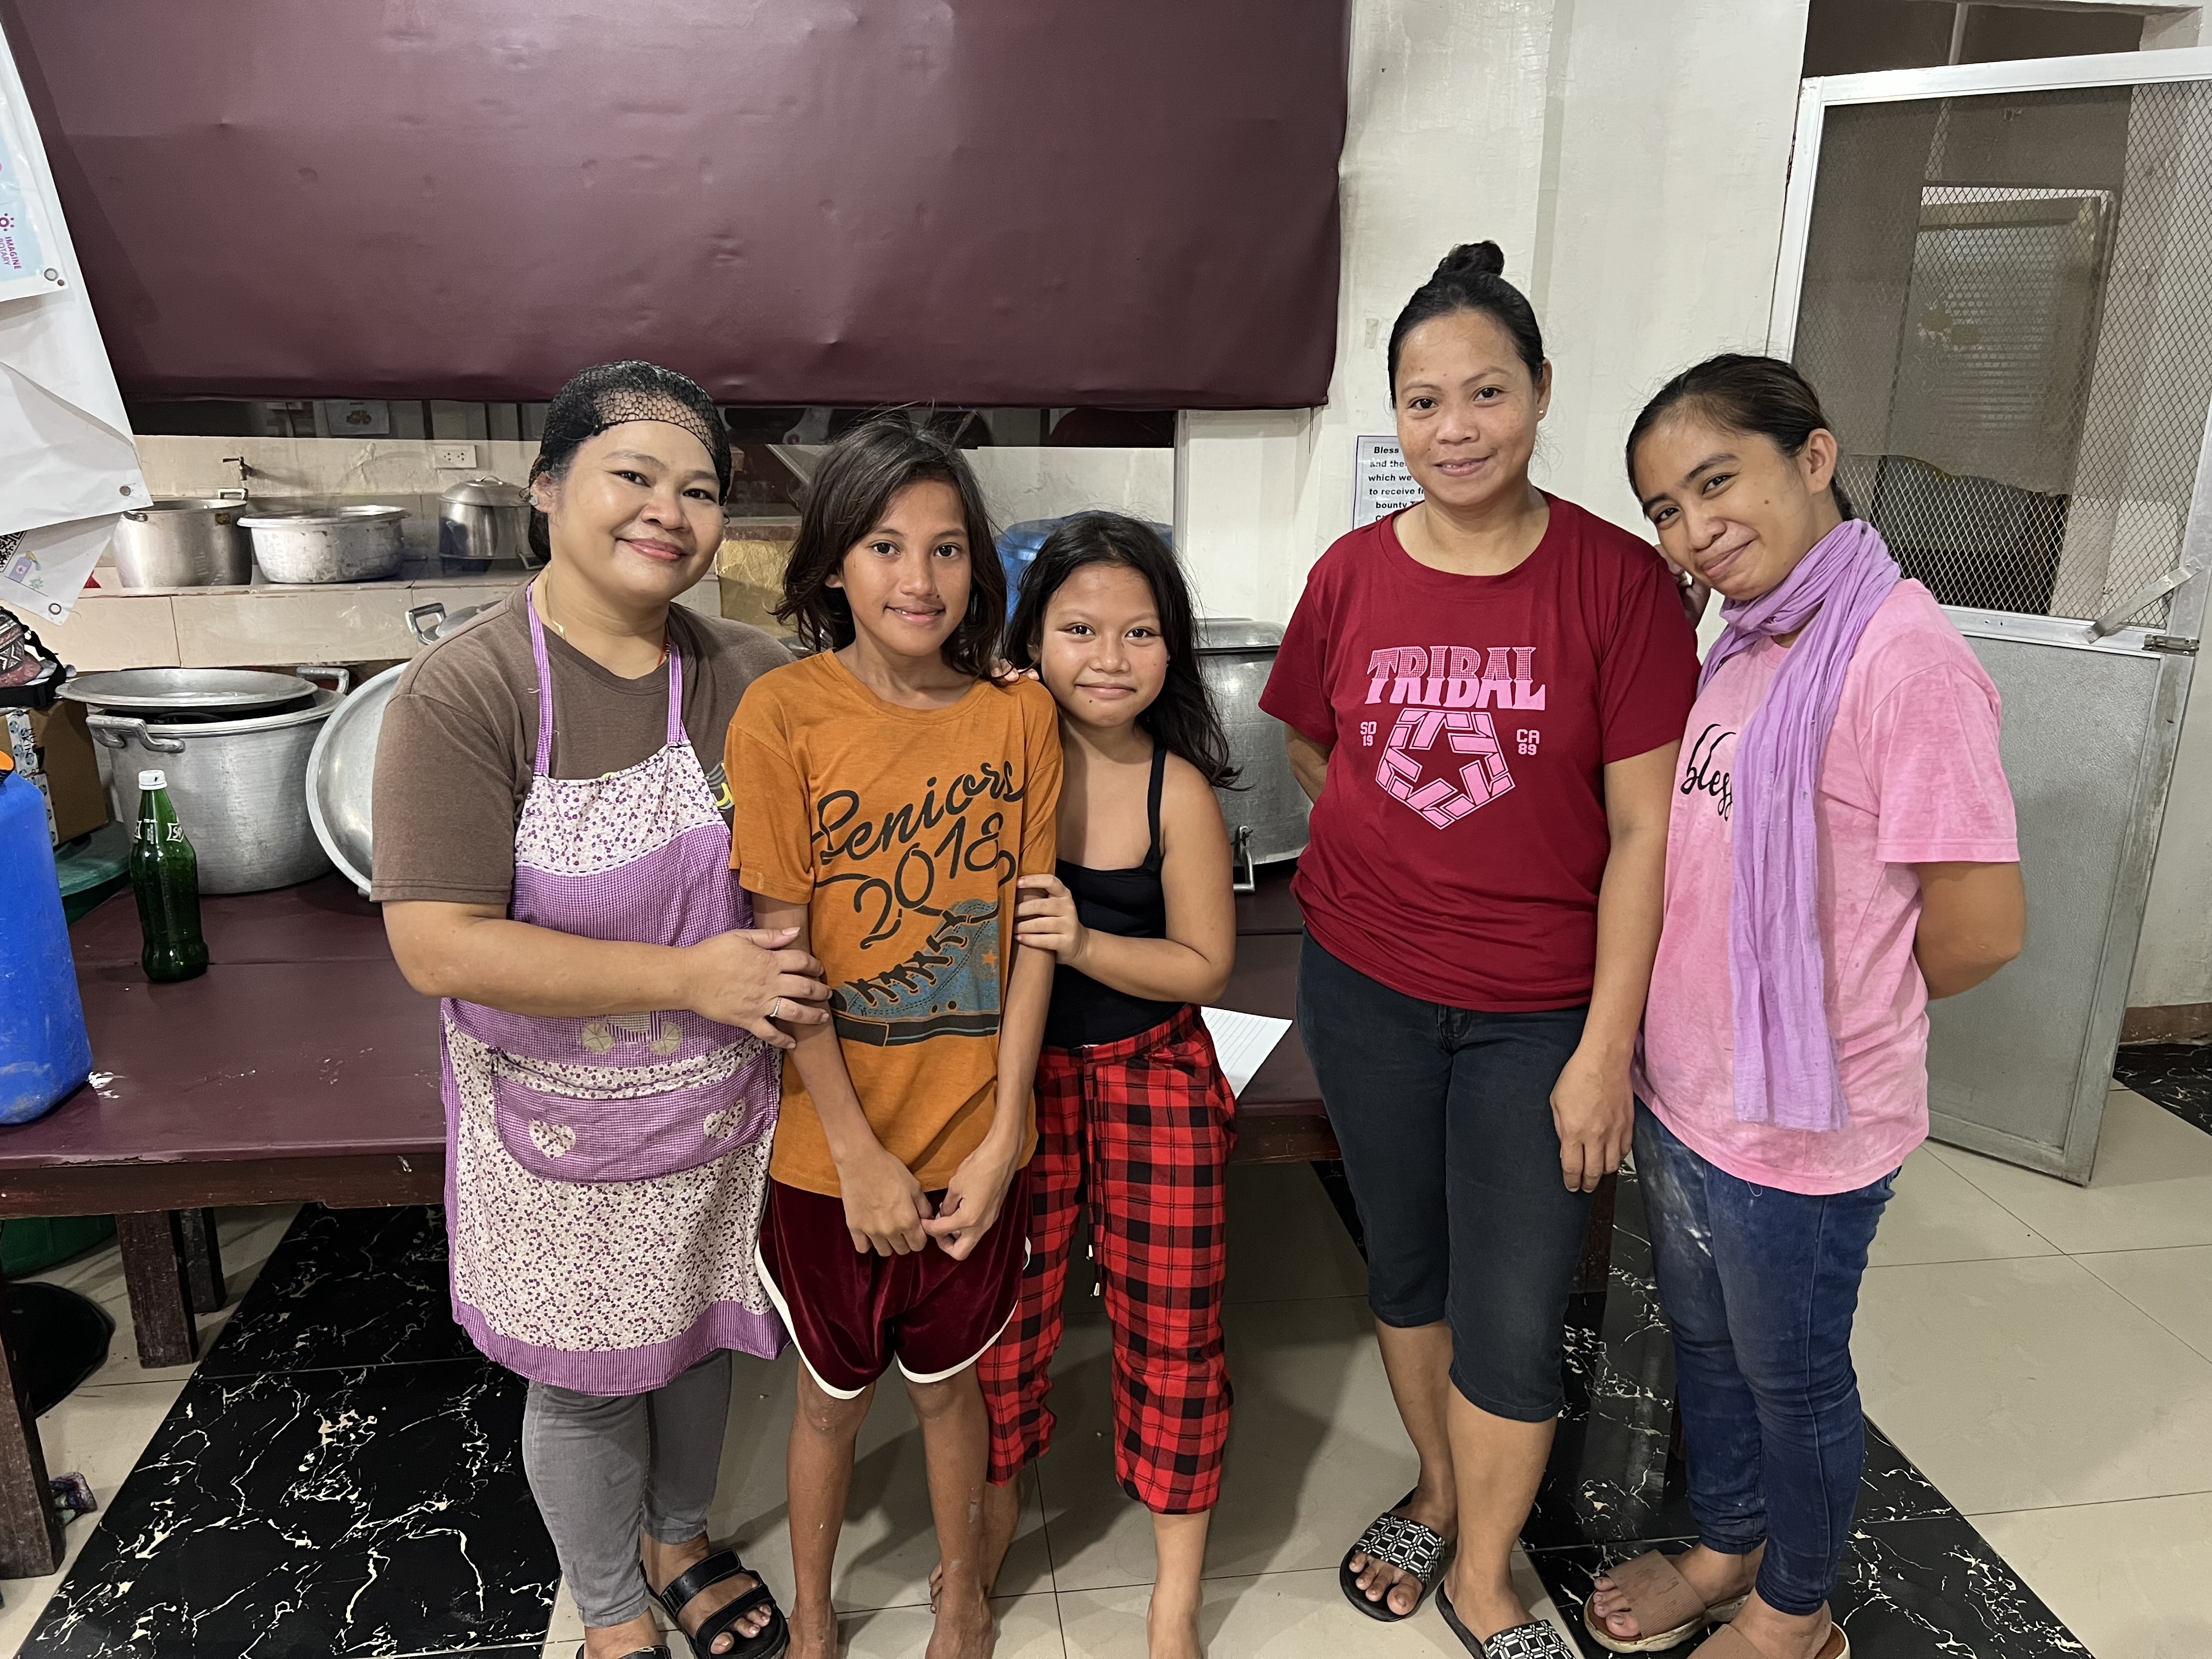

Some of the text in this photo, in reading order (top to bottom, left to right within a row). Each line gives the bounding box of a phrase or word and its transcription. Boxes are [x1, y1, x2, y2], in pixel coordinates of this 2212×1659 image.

[5, 236, 22, 269] IMAGINE
[1364, 645, 1545, 710] TRIBAL
[1360, 721, 1540, 744] SD CA
[1362, 735, 1537, 755] 19 89
[812, 760, 1025, 865] Seniors
[853, 812, 1016, 950] 2018
